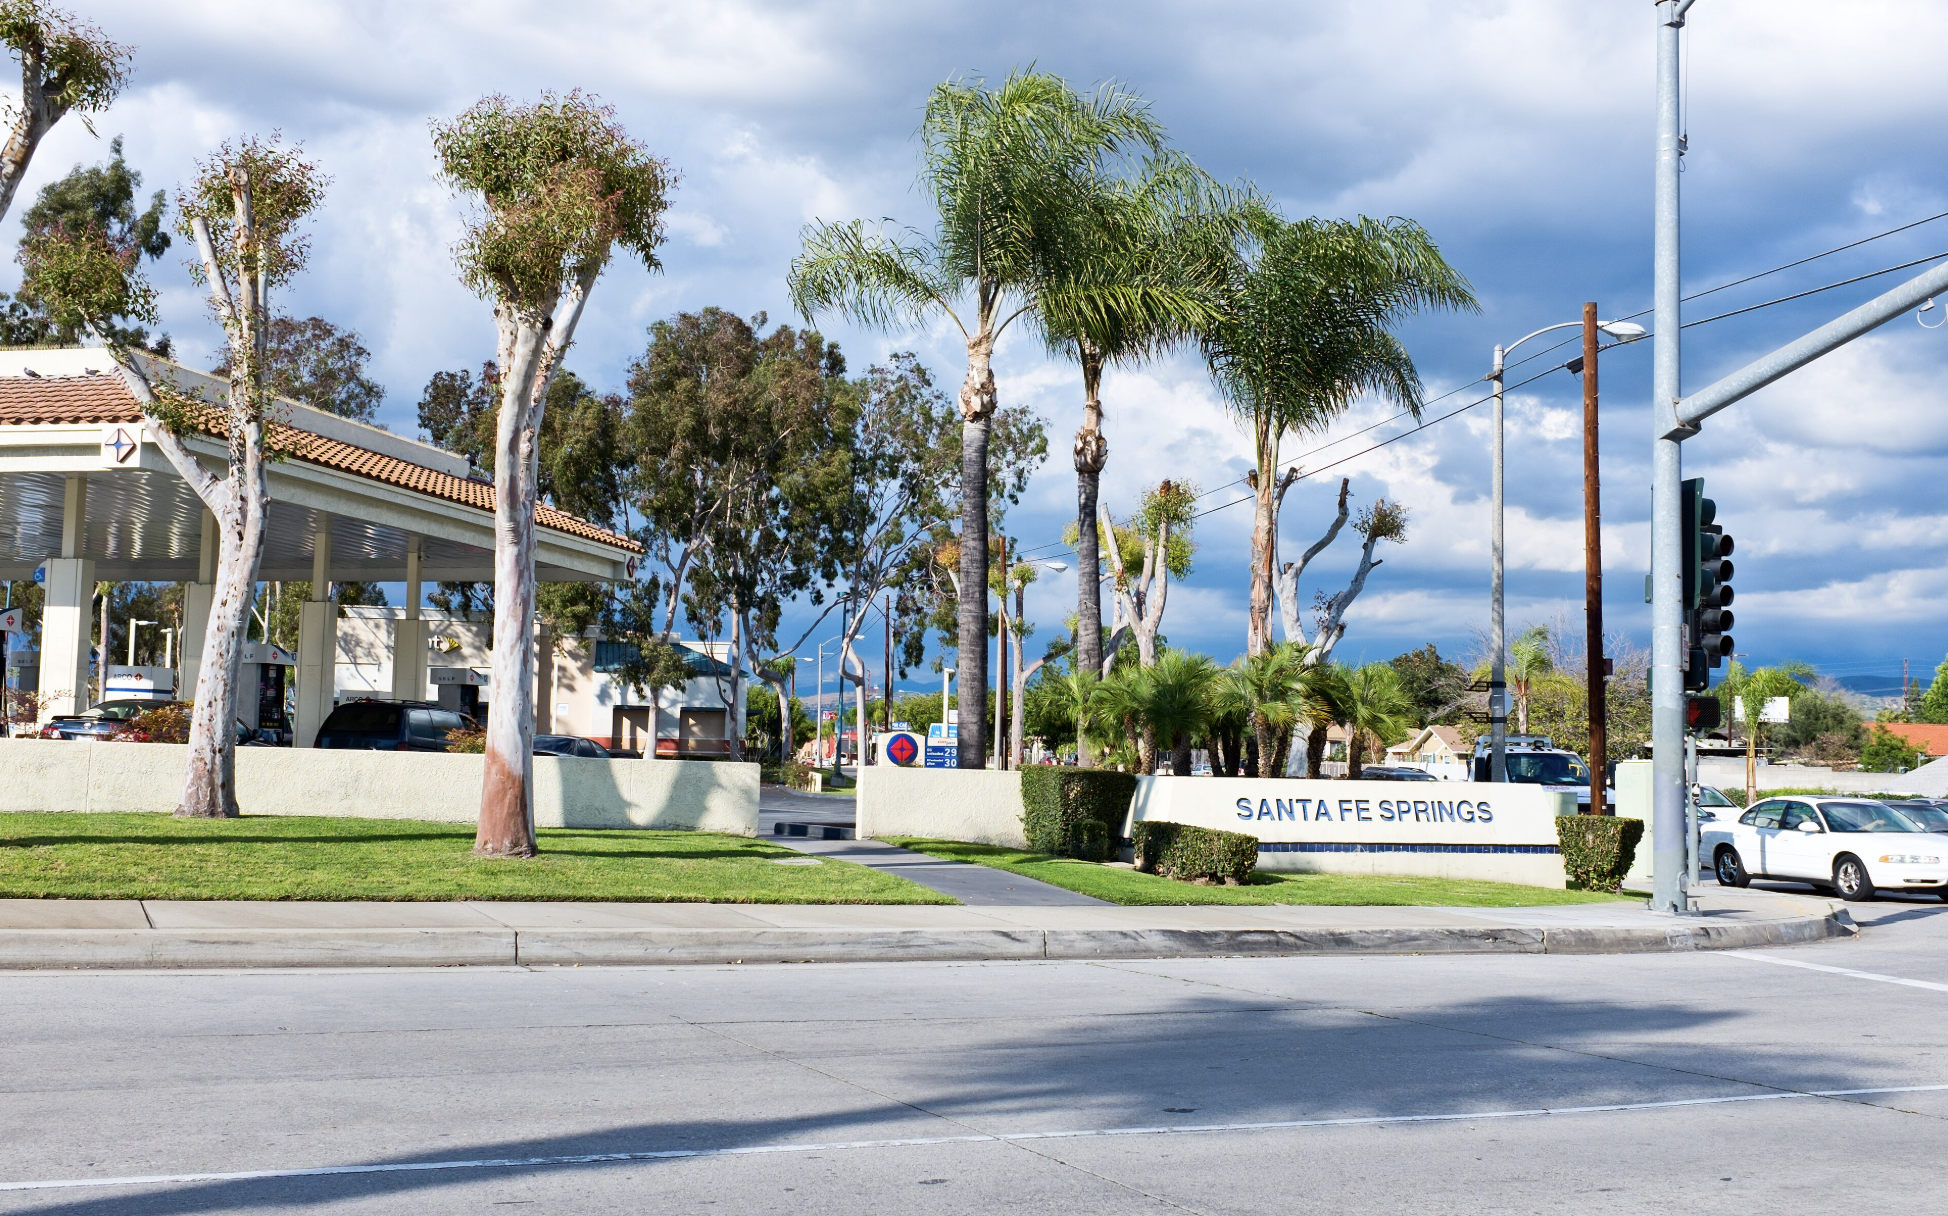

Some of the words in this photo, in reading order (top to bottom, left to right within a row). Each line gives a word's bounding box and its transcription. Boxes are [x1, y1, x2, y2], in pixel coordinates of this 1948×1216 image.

[1236, 797, 1333, 821] SANTA
[1338, 799, 1373, 822] FE
[1379, 800, 1494, 823] SPRINGS
